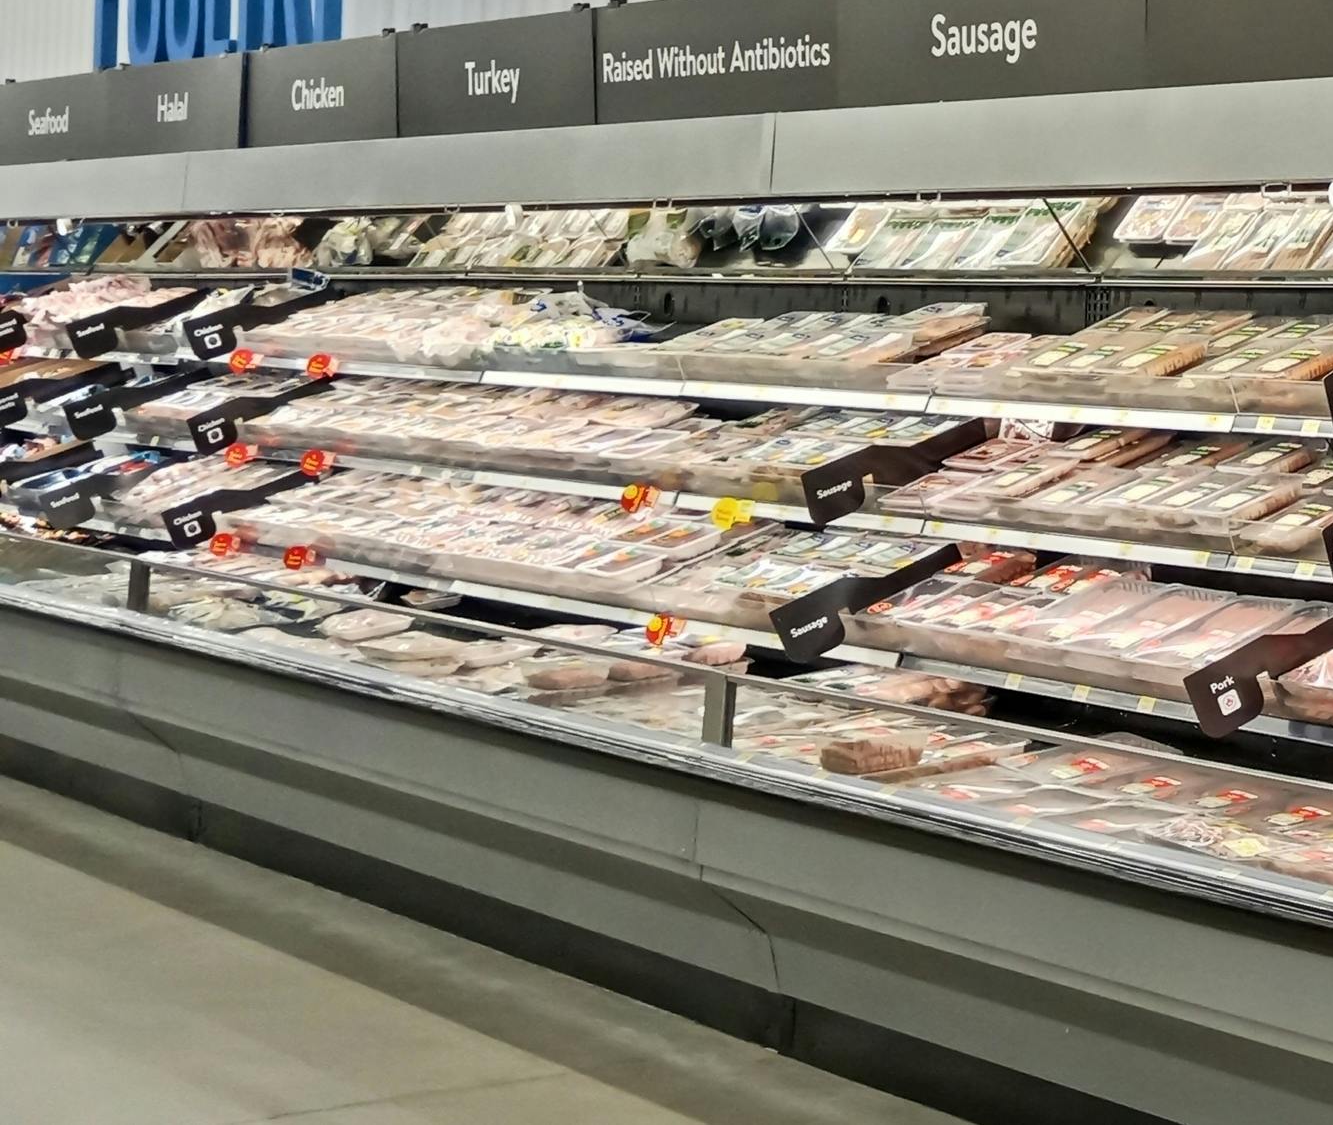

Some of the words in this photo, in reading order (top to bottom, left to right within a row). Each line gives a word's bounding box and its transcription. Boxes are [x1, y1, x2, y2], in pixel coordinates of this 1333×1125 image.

[930, 12, 1038, 64] Sausage
[602, 48, 653, 83] Raised
[656, 44, 726, 79] Without
[729, 34, 831, 73] Antibiotics
[291, 77, 344, 111] Chicken
[465, 60, 520, 103] Turkey
[28, 106, 69, 136] Seafood
[156, 92, 189, 123] Halal
[816, 480, 852, 500] Sausage
[790, 616, 828, 638] Sausage
[1210, 675, 1235, 694] Pork
